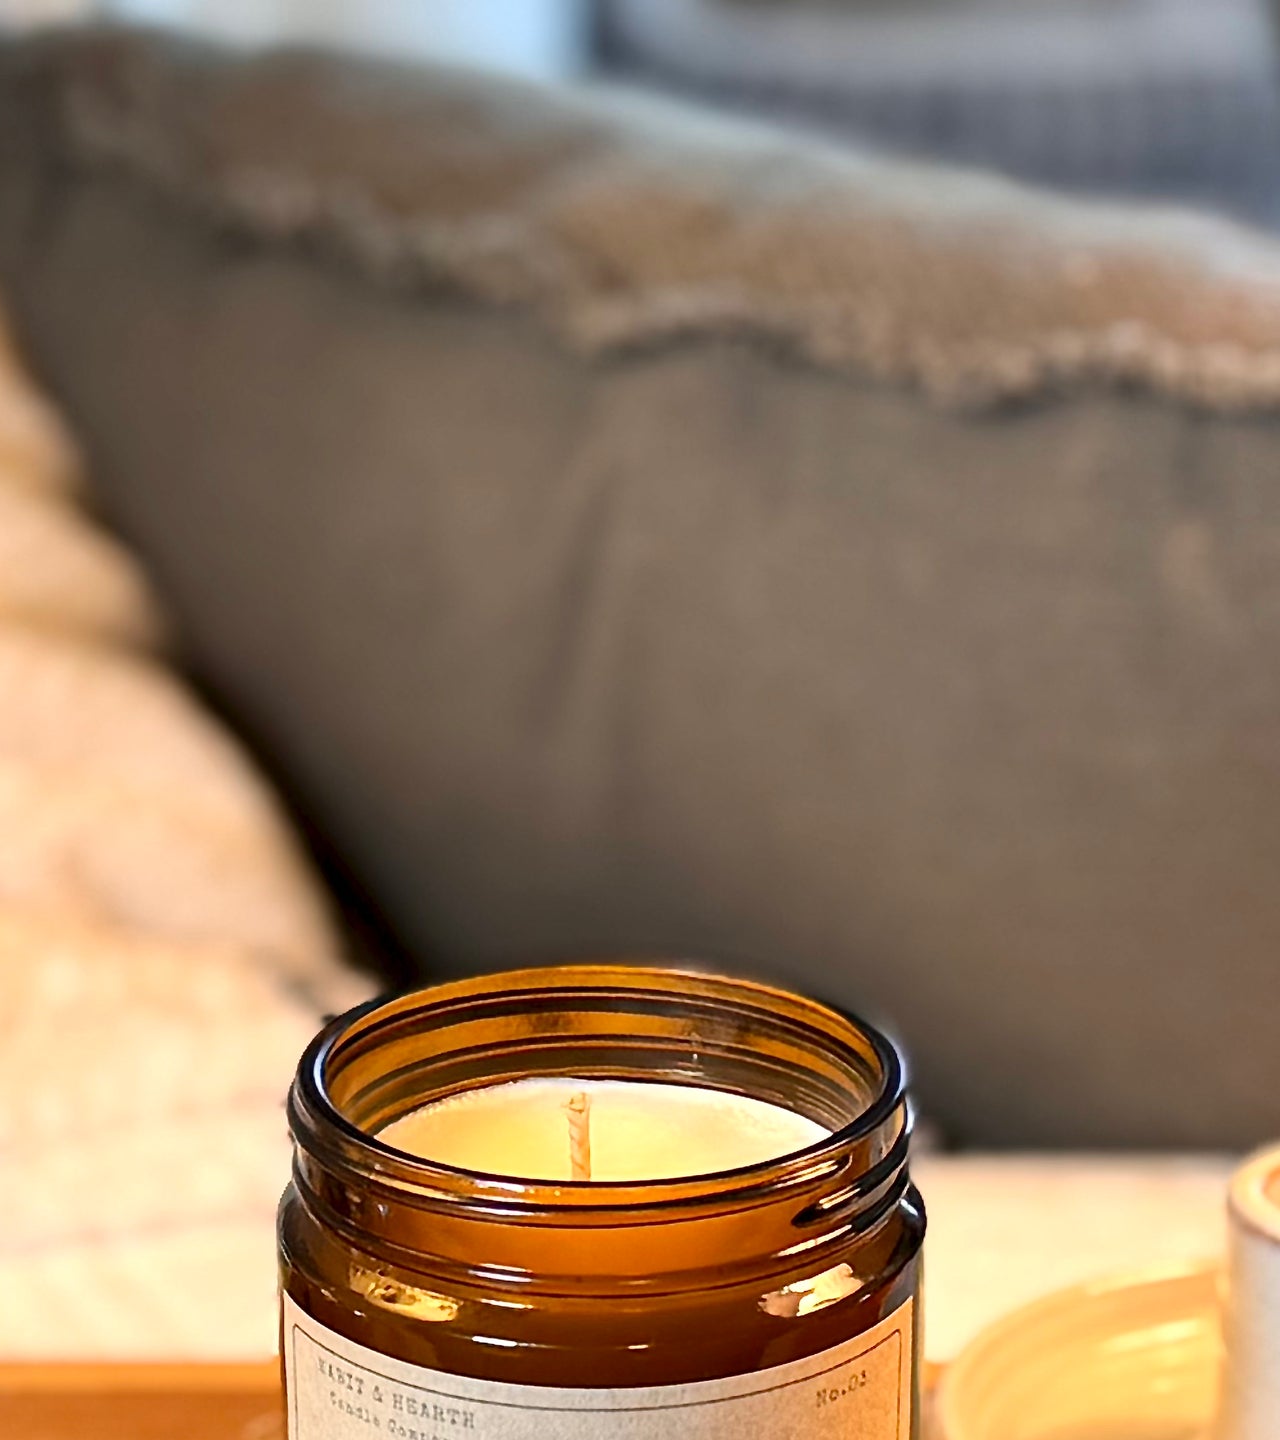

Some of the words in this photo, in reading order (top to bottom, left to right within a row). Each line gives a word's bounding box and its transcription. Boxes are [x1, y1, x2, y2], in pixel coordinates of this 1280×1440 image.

[318, 1356, 365, 1395] HABIT
[372, 1385, 384, 1403] &
[392, 1392, 475, 1429] HEARTH
